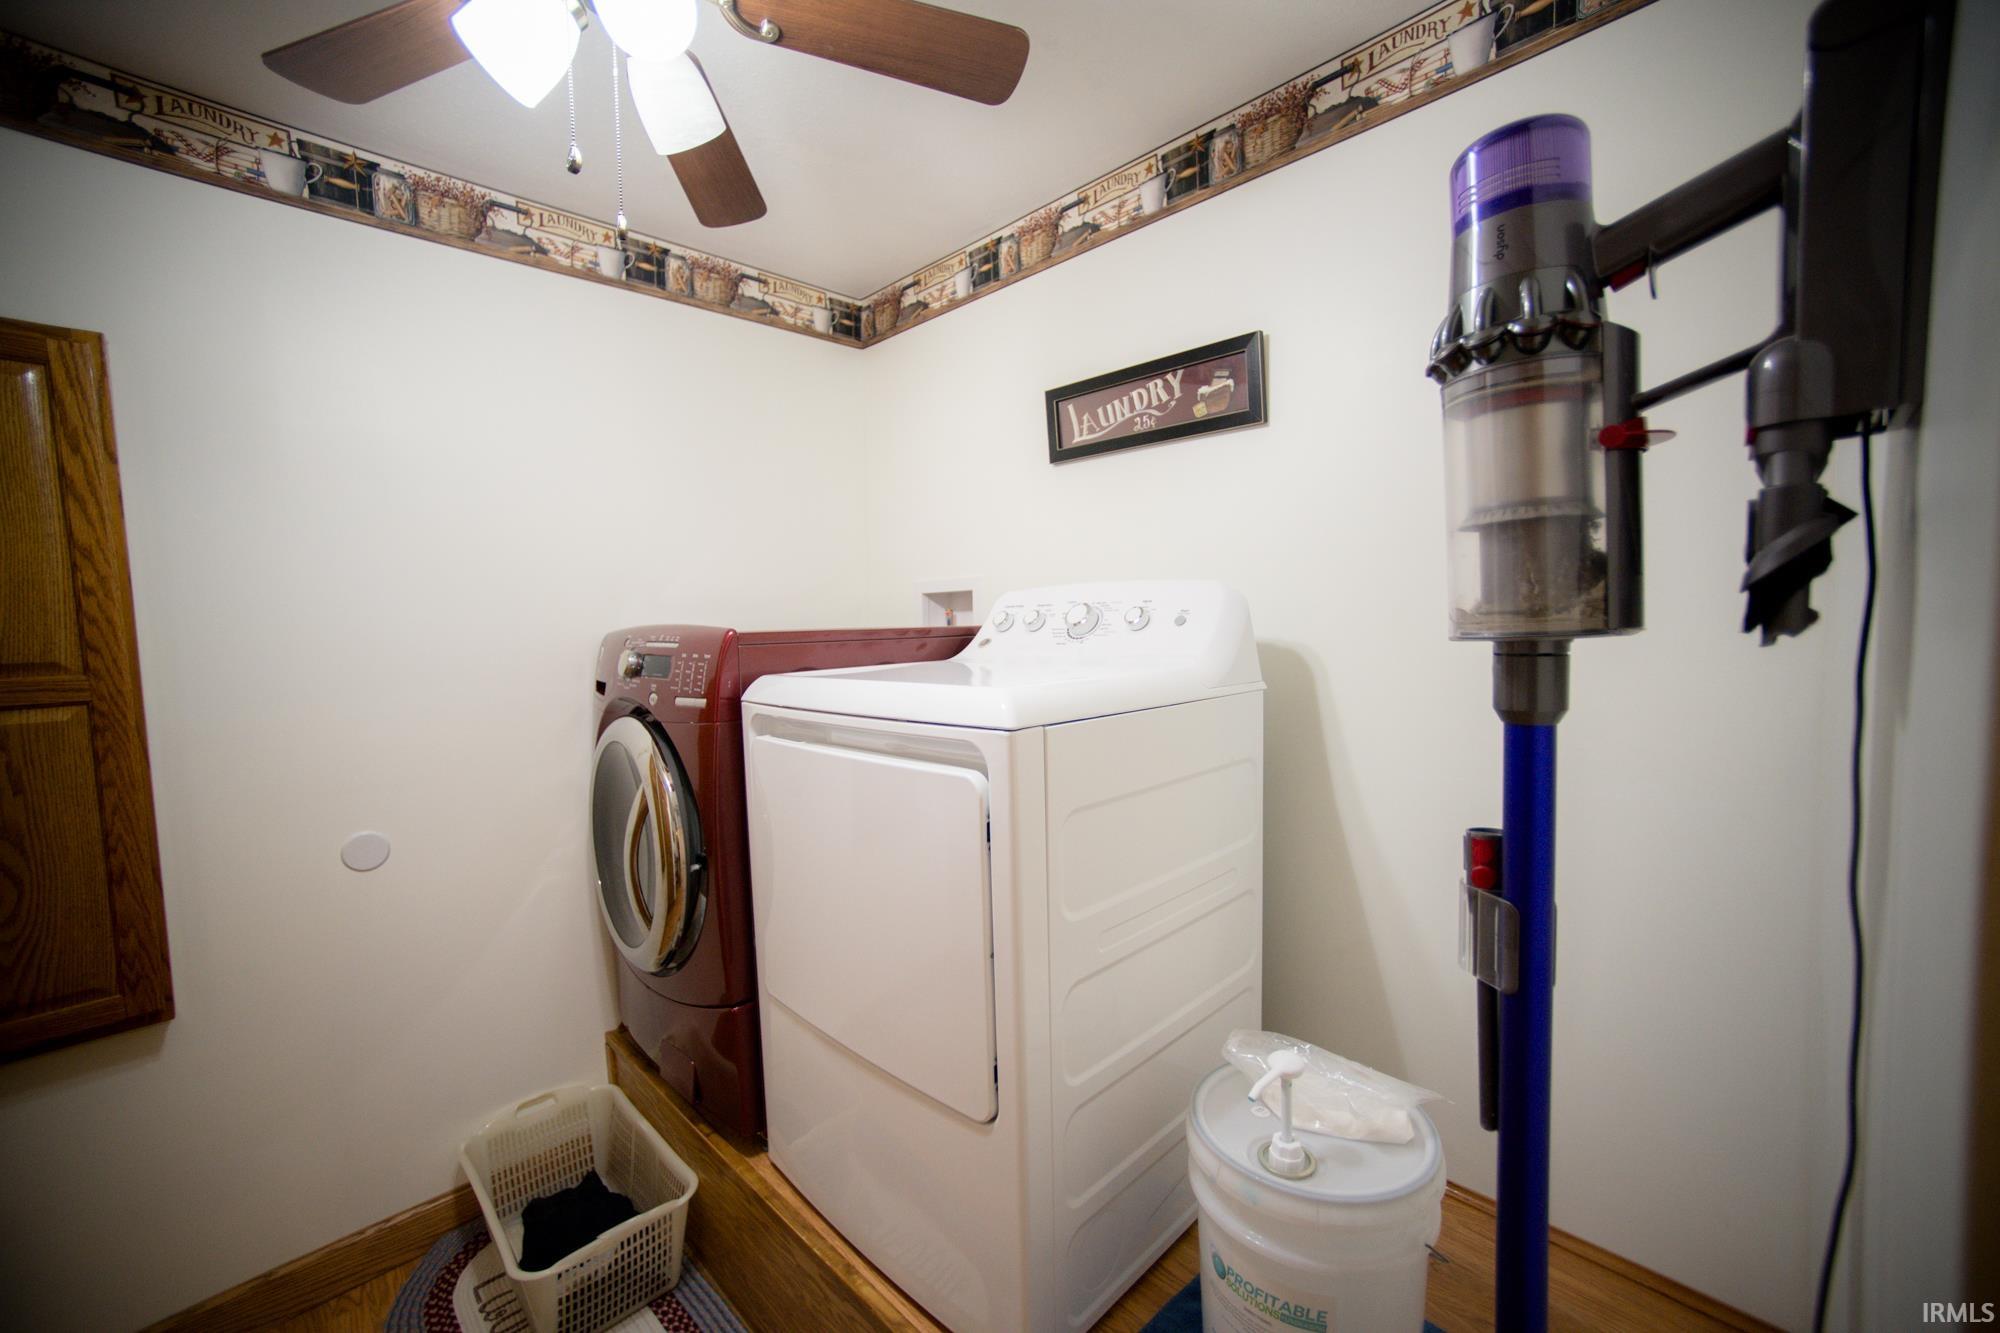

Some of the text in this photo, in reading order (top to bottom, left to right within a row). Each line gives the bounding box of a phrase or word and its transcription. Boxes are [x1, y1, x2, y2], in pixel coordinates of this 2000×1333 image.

[1366, 16, 1452, 72] LAUNDRY
[154, 95, 260, 145] LAUNDRY
[1092, 170, 1142, 204] LAUNDRY
[538, 212, 599, 242] LAUNDRY
[1493, 223, 1510, 262] dyson
[773, 281, 814, 304] LAUNDRY
[1067, 368, 1186, 444] LAUNDRY
[1226, 1265, 1329, 1324] PROFITABLE
[1226, 1278, 1281, 1320] SOLUTIONS
